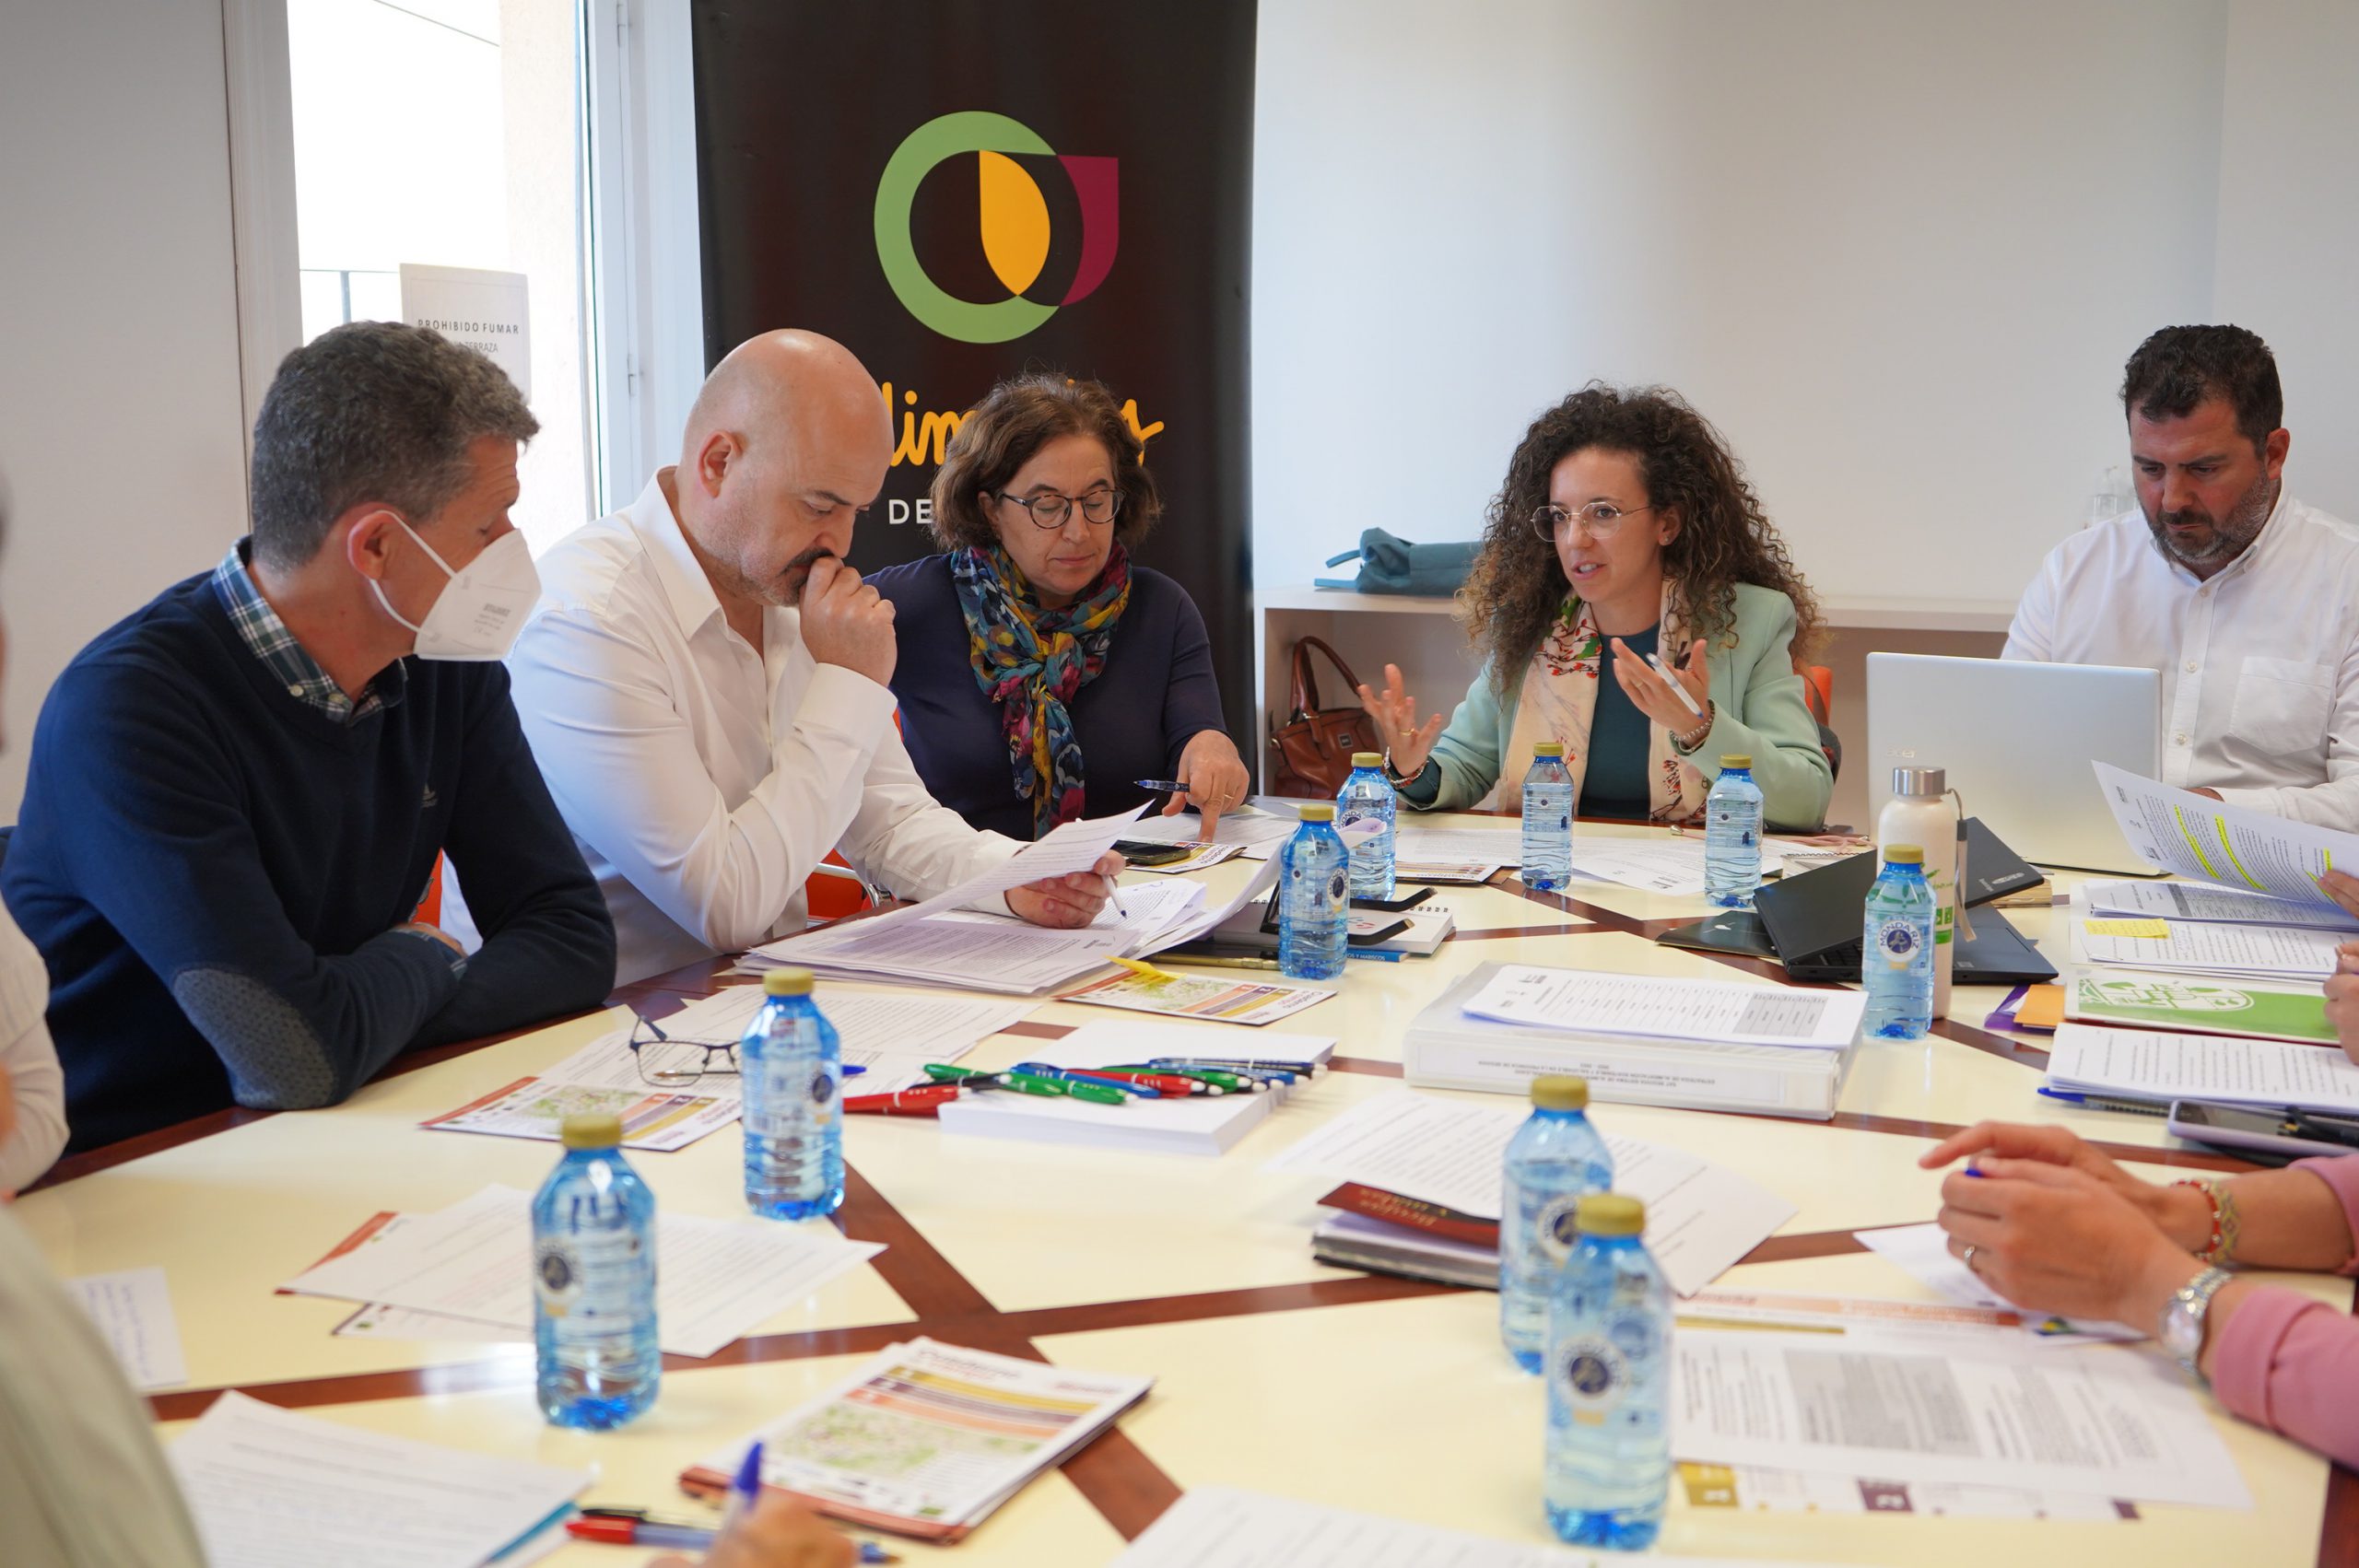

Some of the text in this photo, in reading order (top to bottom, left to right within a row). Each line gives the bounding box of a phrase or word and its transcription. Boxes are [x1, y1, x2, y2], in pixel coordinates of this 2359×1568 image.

[417, 319, 520, 334] PROHIBIDO FUMAR
[1880, 922, 1919, 950] MONDARIZ
